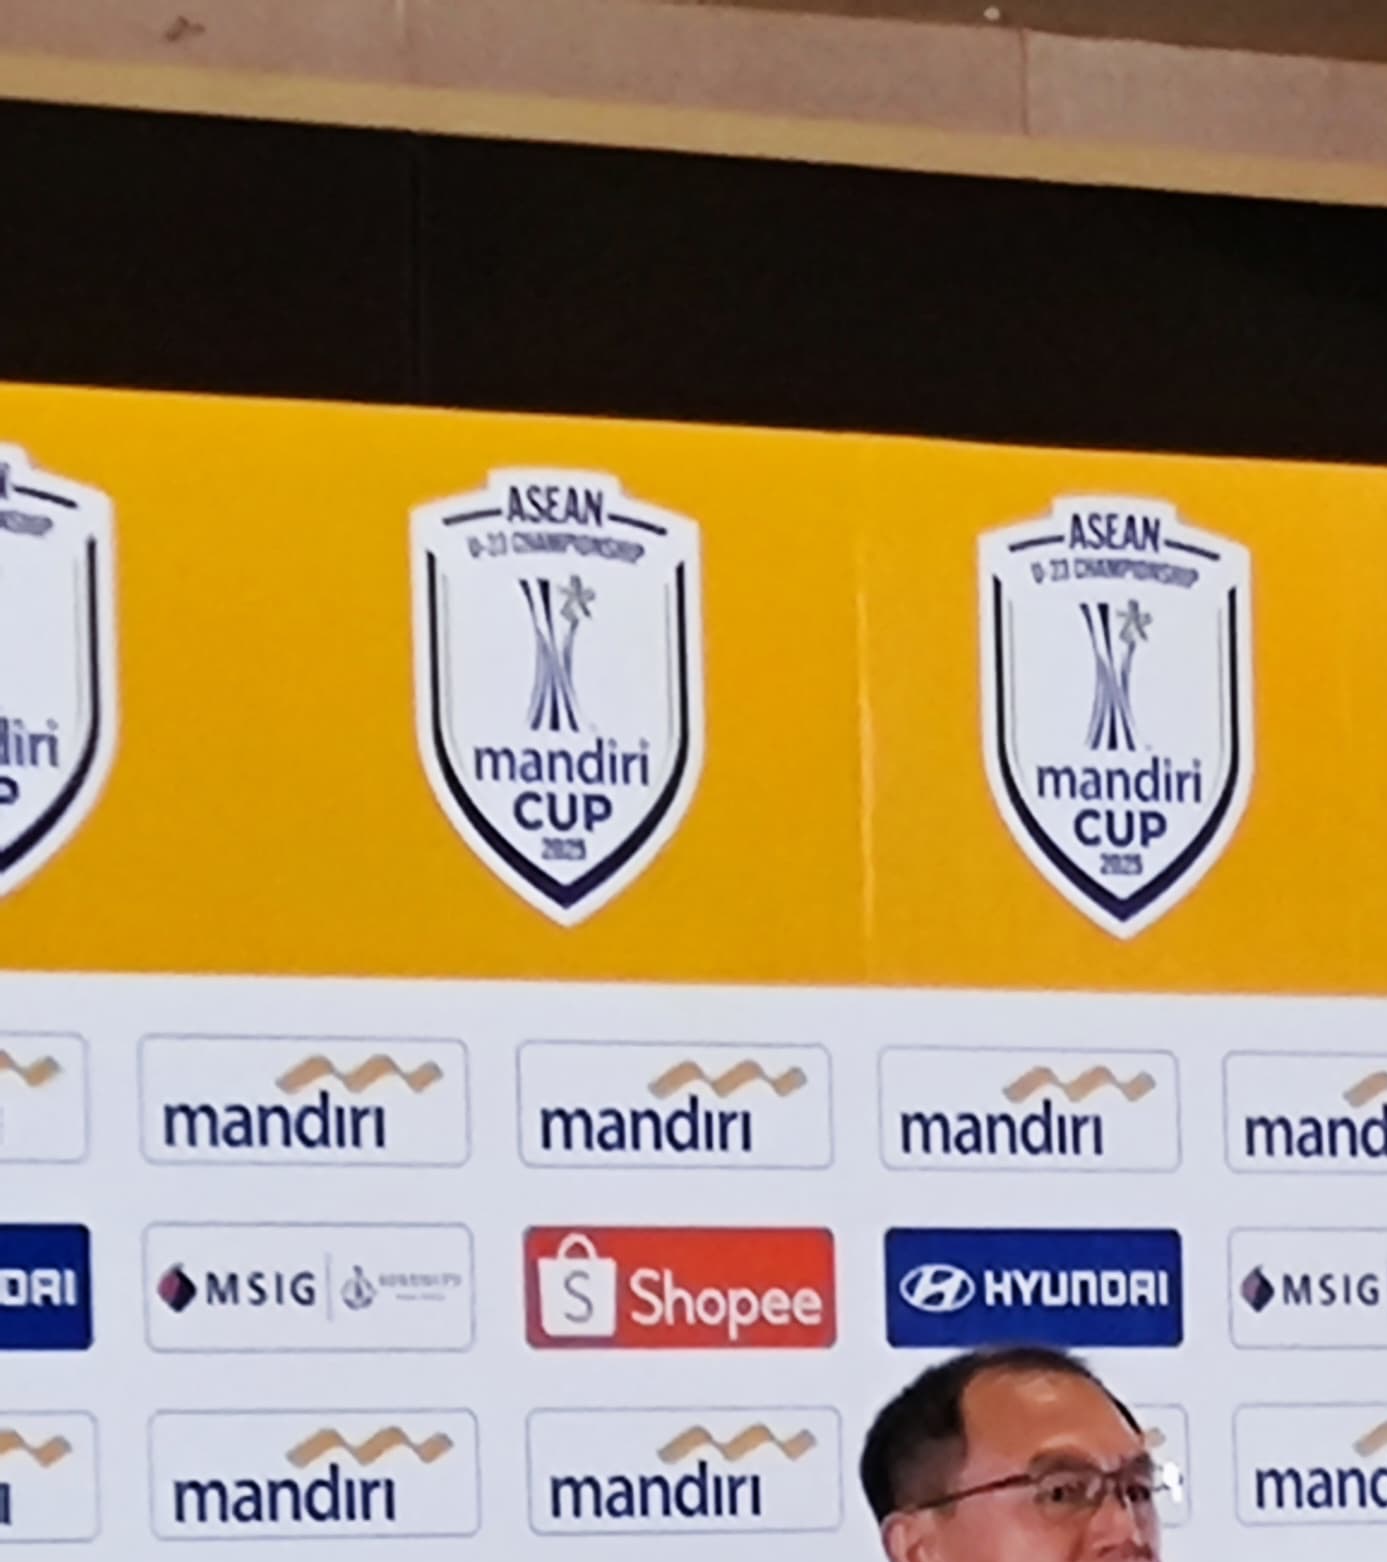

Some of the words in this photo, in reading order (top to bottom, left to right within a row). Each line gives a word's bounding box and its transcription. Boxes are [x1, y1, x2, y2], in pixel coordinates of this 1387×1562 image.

[506, 484, 604, 528] ASEAN
[1069, 512, 1161, 553] ASEAN
[473, 736, 649, 787] mandiri
[1036, 755, 1202, 804] mandiri
[513, 790, 613, 833] CUP
[1073, 808, 1168, 848] CUP
[163, 1089, 385, 1149] mandiri
[540, 1094, 752, 1153] mandiri
[900, 1098, 1103, 1156] mandiri
[205, 1271, 316, 1307] MSIG
[629, 1267, 823, 1341] Shopee
[983, 1269, 1169, 1307] HYUNDAI
[1282, 1273, 1380, 1307] MSIG
[173, 1462, 396, 1523] mandiri
[550, 1459, 762, 1519] mandiri
